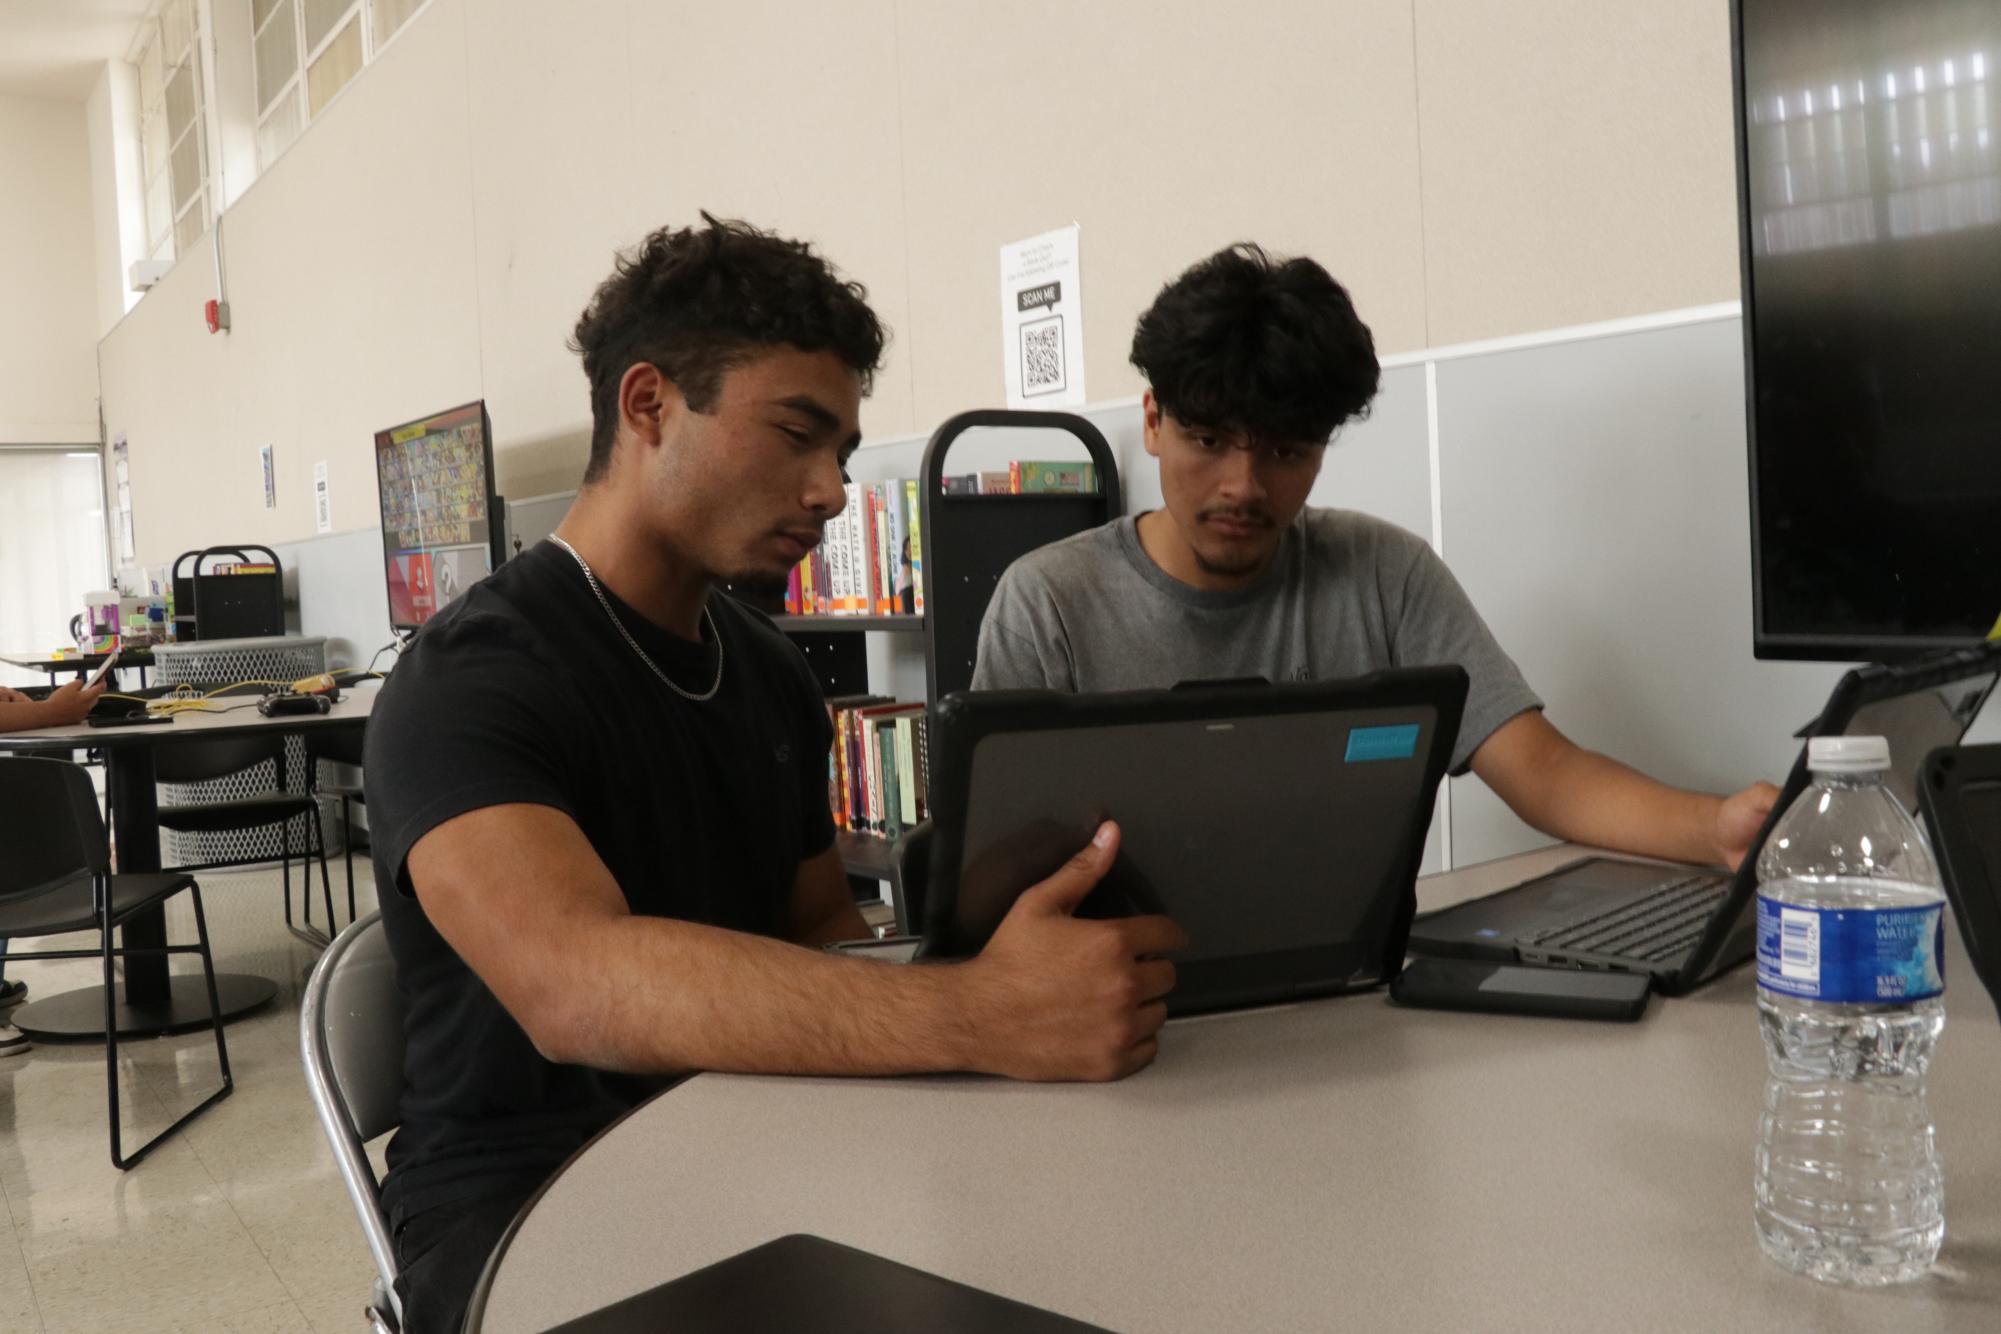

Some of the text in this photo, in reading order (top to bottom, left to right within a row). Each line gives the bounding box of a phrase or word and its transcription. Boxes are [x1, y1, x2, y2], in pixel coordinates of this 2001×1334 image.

[1022, 286, 1056, 307] SCAN ME
[850, 499, 859, 517] THE
[839, 520, 848, 540] THE
[829, 520, 841, 595] THE COME UP
[841, 543, 851, 577] COME
[843, 580, 852, 595] UP
